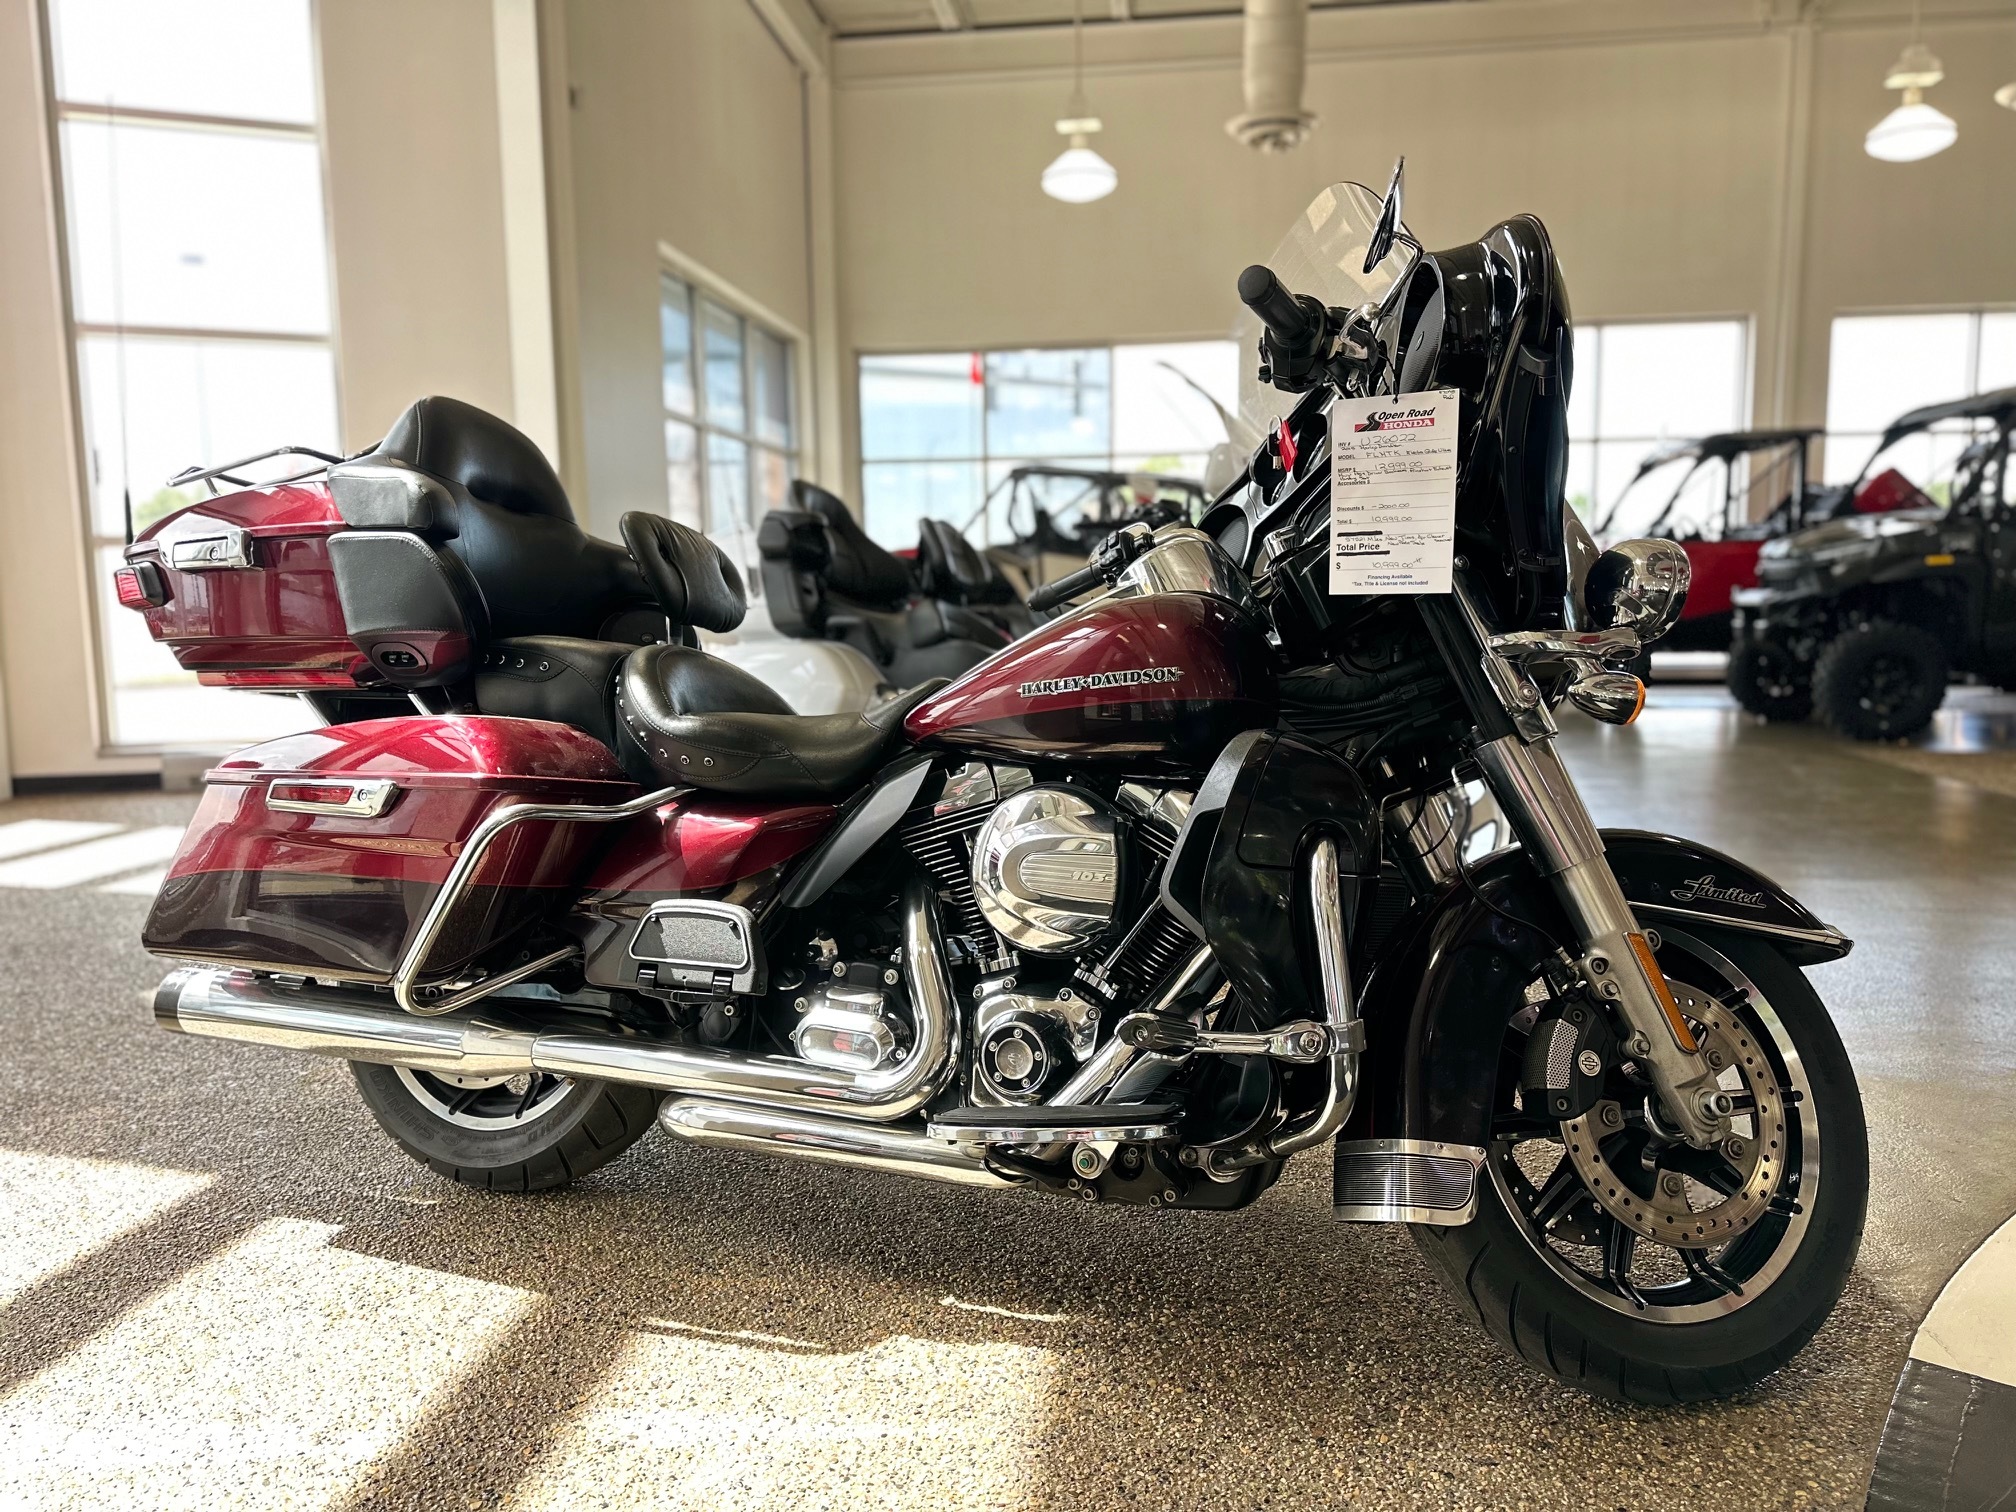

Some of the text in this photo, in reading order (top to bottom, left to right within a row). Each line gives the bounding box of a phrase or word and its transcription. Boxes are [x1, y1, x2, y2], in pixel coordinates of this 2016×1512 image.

[1378, 407, 1436, 422] Open Road
[1383, 419, 1433, 430] HONDA
[1335, 562, 1341, 570] $
[1670, 874, 1767, 909] Limited
